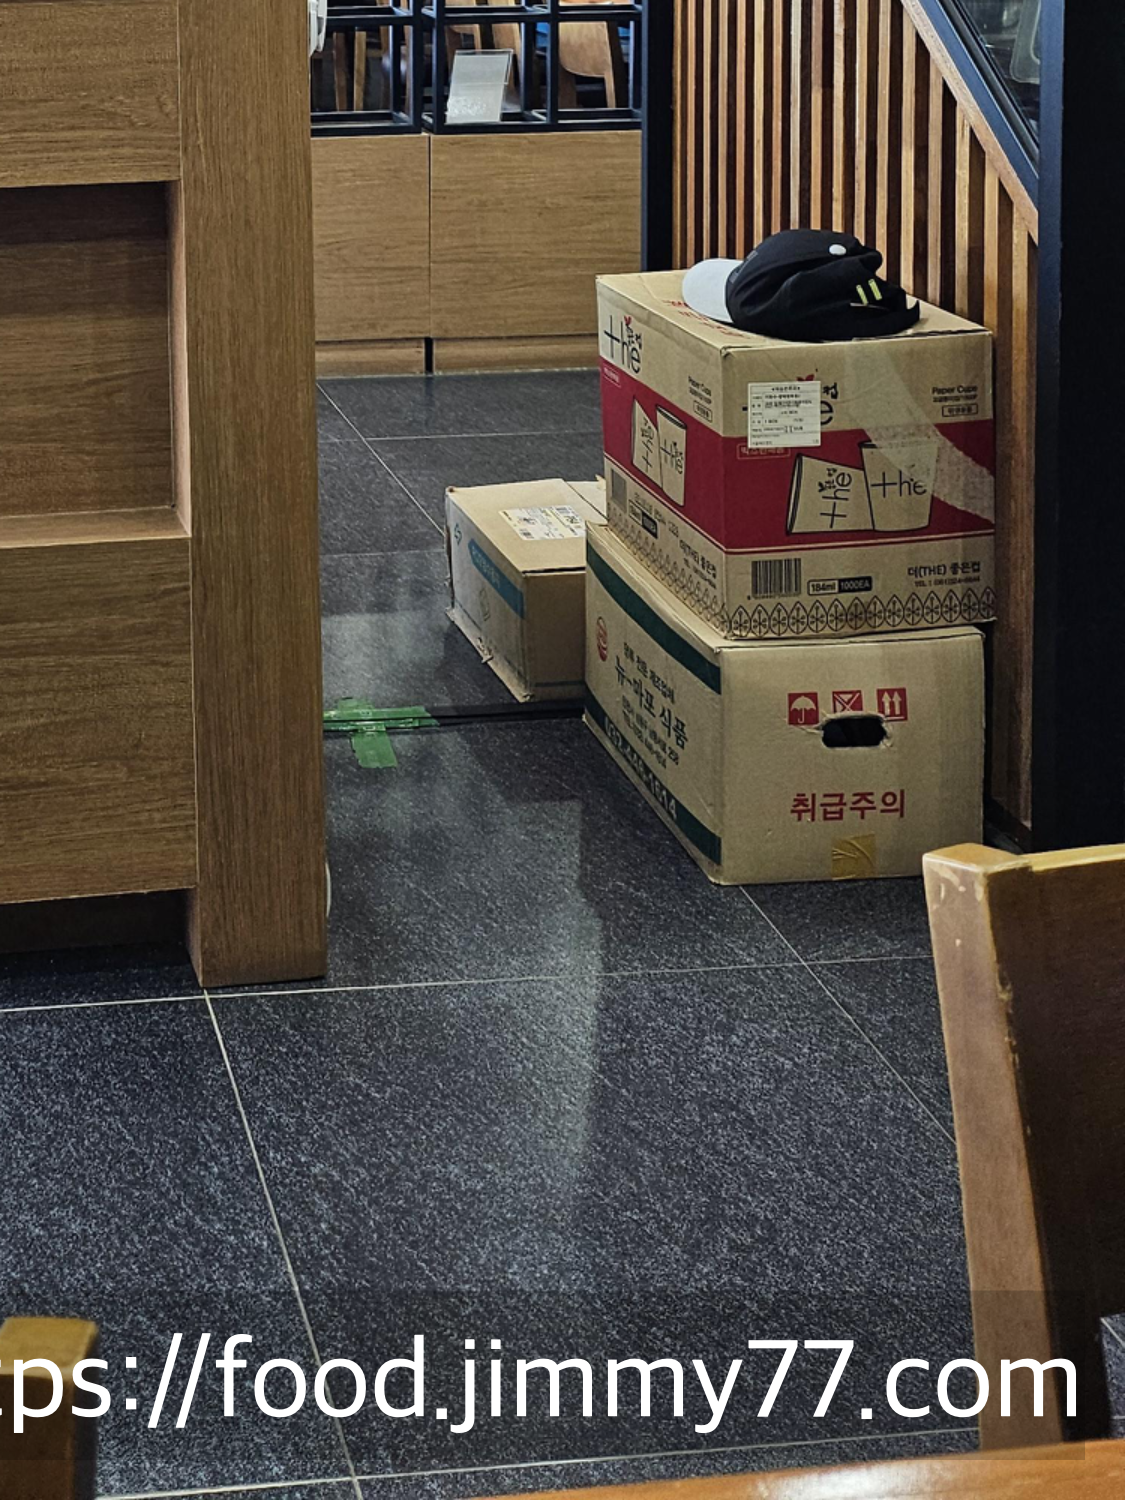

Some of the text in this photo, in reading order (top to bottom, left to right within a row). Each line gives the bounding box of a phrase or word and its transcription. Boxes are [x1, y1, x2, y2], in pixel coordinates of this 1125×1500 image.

[932, 387, 955, 396] Paper
[871, 469, 928, 499] the
[907, 561, 982, 579] 더(THE) 좋은컵
[810, 579, 871, 593] 184ml 1000EA
[660, 706, 689, 751] 식품
[790, 788, 906, 823] 취급주의
